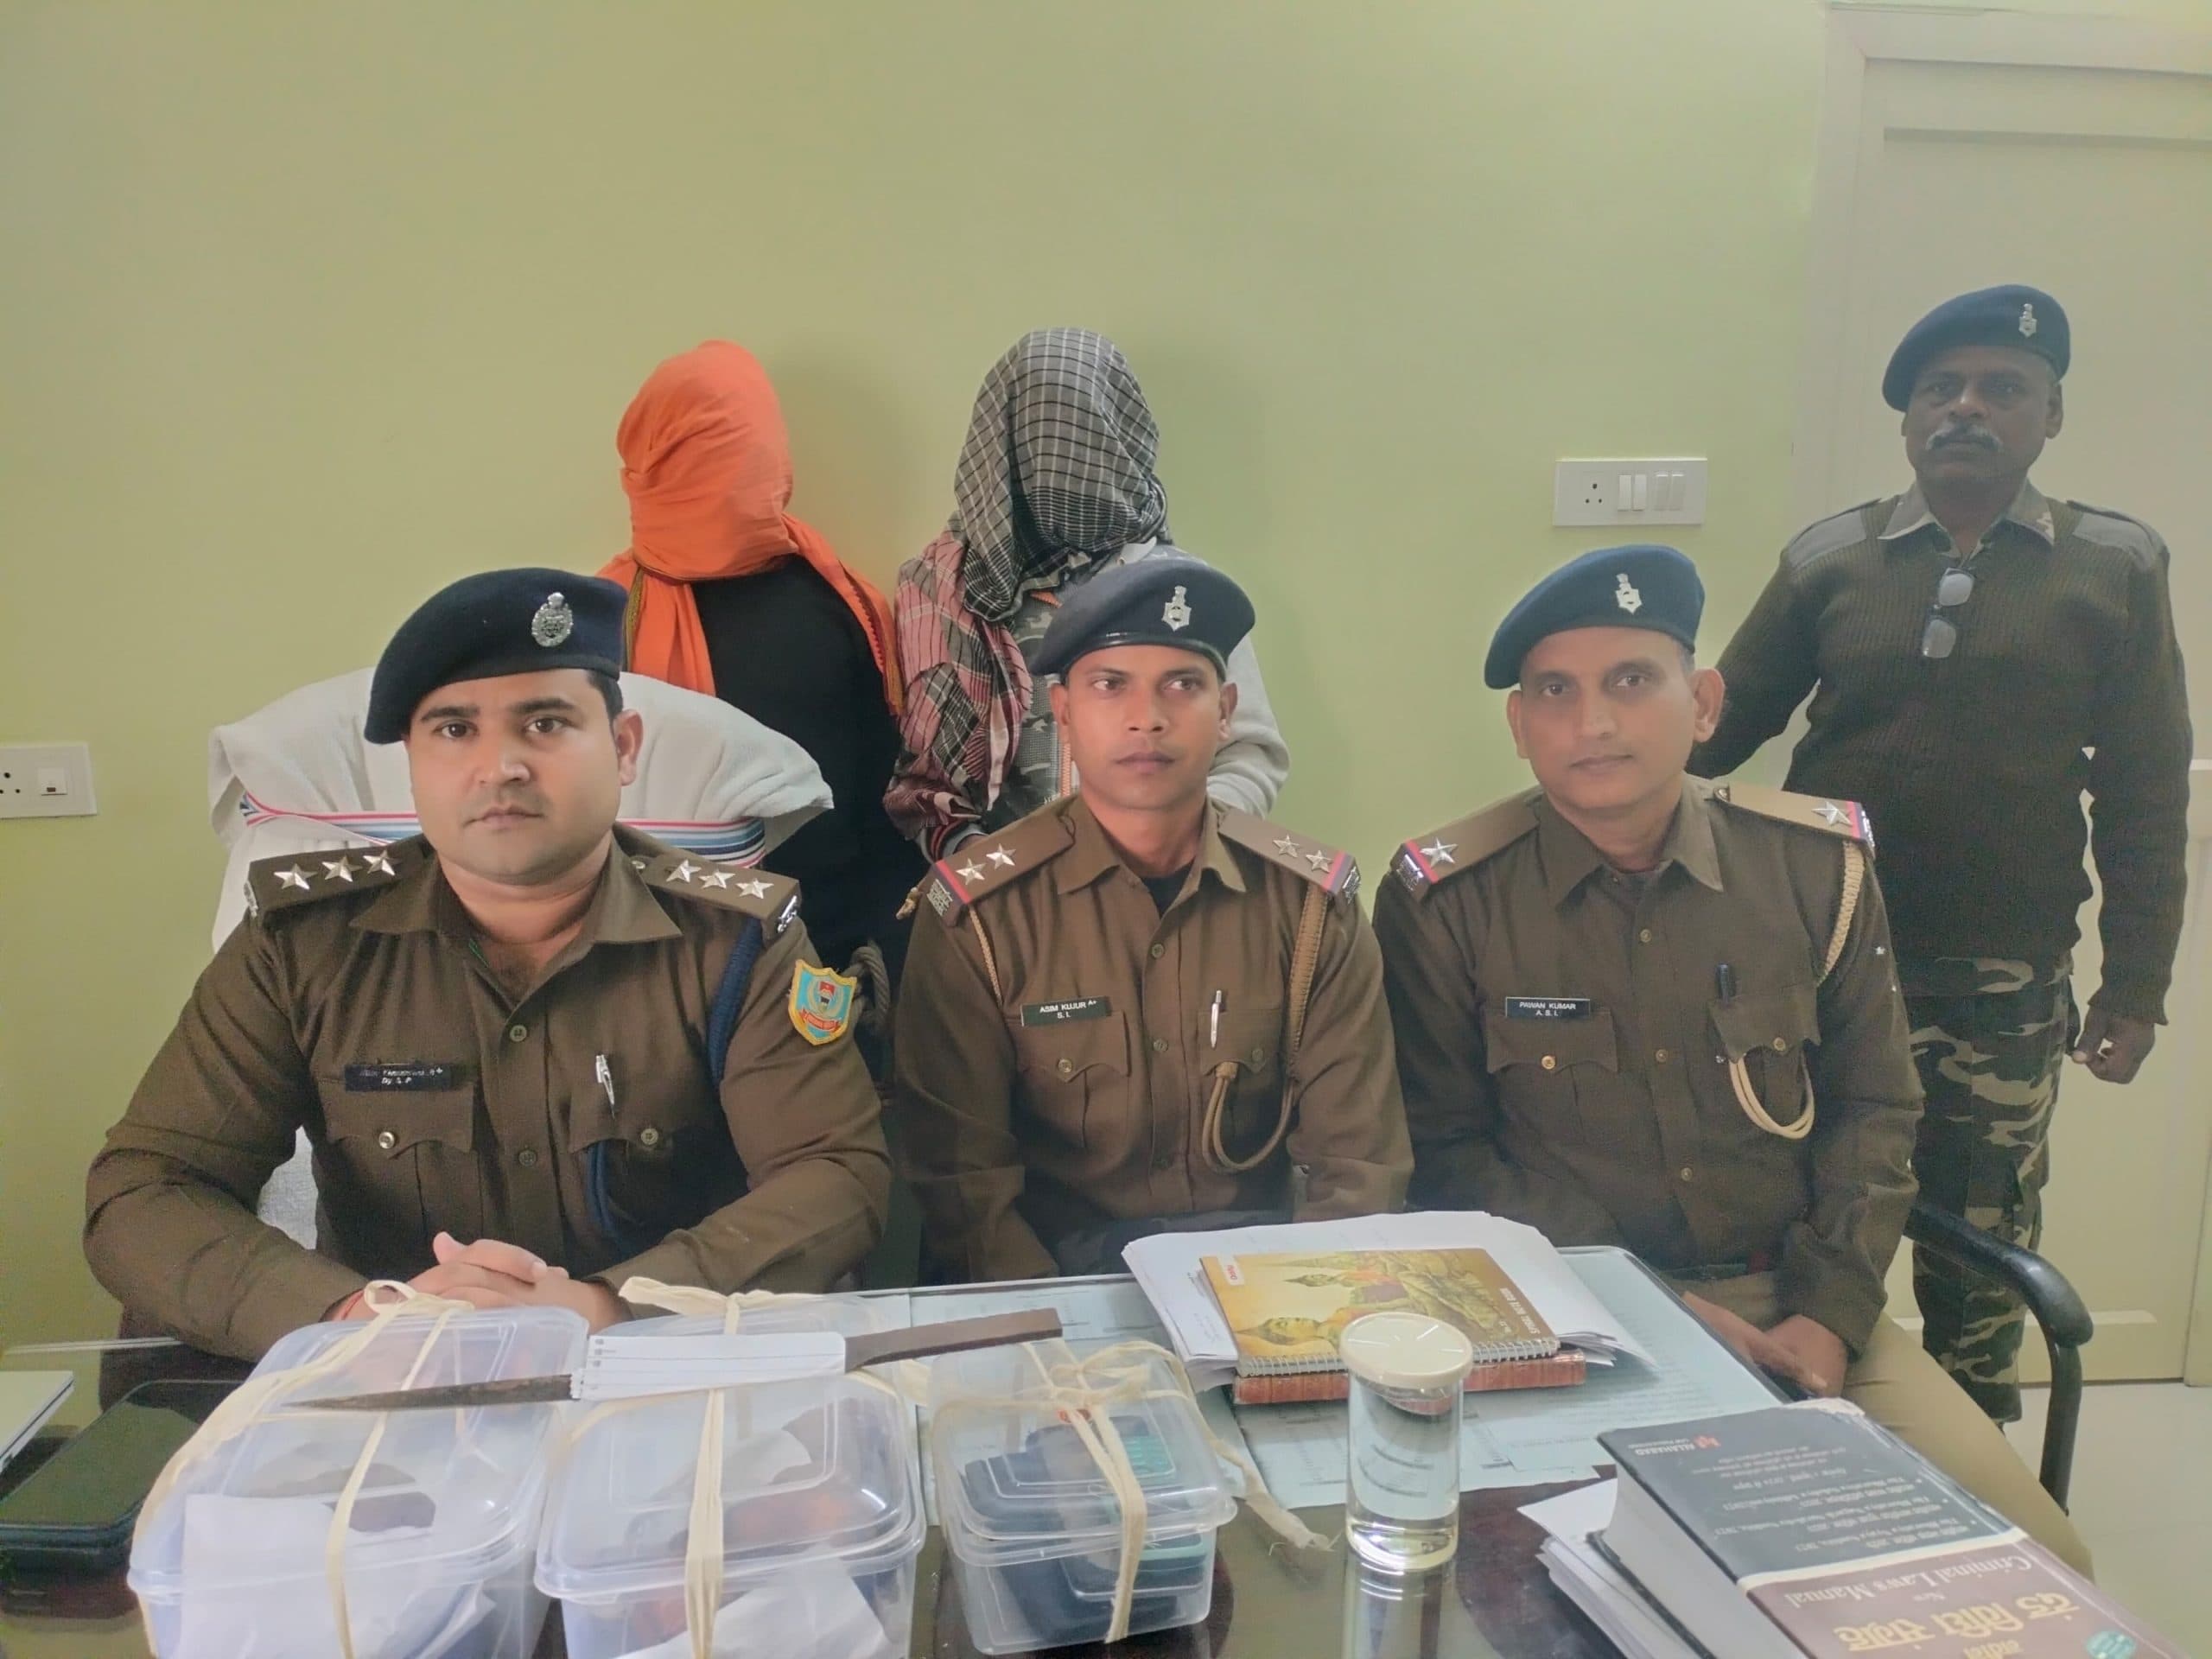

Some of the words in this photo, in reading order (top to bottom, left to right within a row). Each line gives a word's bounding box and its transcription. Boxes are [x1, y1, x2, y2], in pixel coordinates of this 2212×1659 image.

[1874, 1572, 1938, 1592] Laws
[1935, 1555, 2032, 1582] Criminal
[1785, 1583, 1876, 1609] Manual
[2017, 1592, 2079, 1622] दंड
[1930, 1603, 2024, 1638] विधि
[1834, 1619, 1936, 1651] संग्रह
